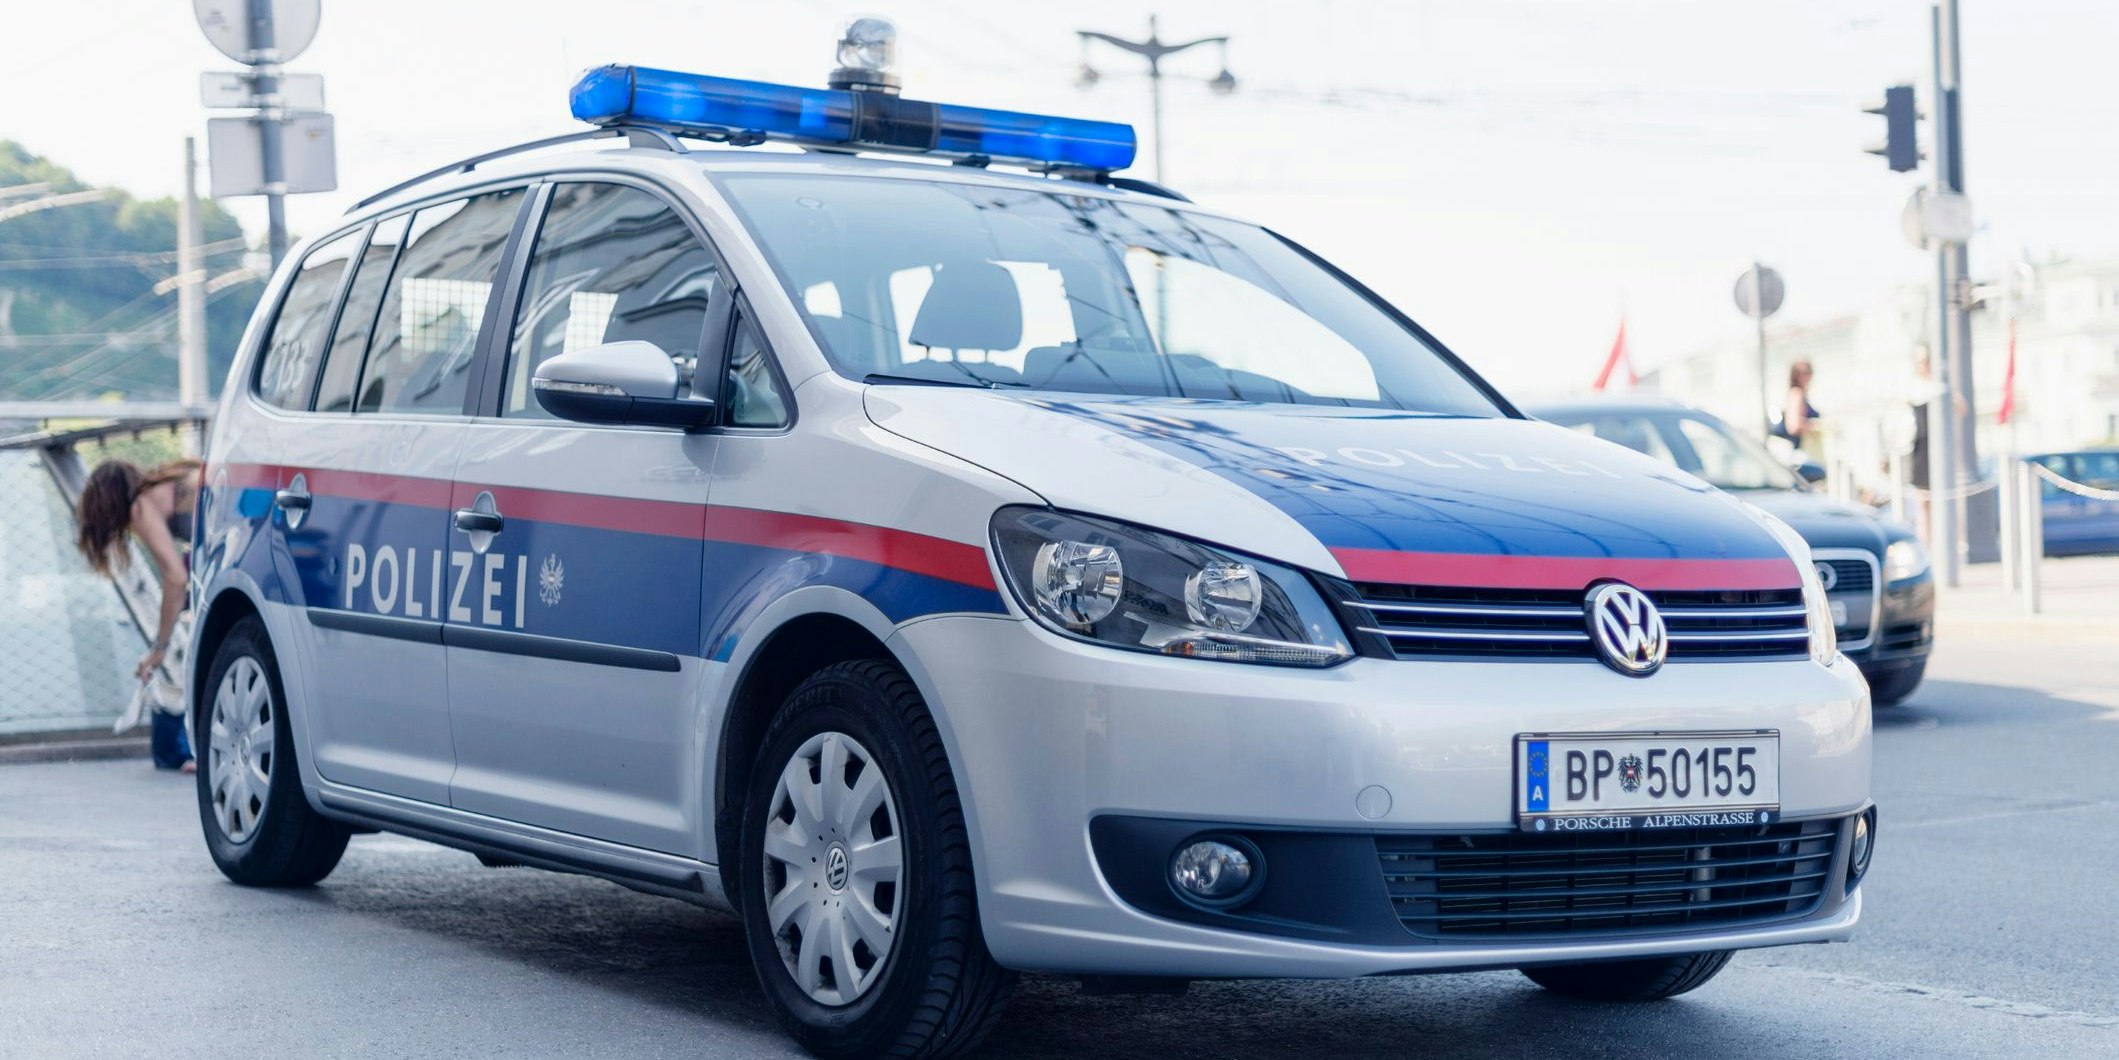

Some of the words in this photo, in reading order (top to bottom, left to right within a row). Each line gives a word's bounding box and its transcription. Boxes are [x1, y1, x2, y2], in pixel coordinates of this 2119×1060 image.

[1276, 447, 1622, 479] POLIZEI
[345, 543, 528, 628] POLIZEI
[1566, 749, 1614, 801] BP
[1647, 746, 1757, 798] 50155
[1532, 785, 1544, 801] A
[1553, 816, 1632, 831] PORSCHE
[1643, 812, 1754, 828] ALPENSTRASSE
